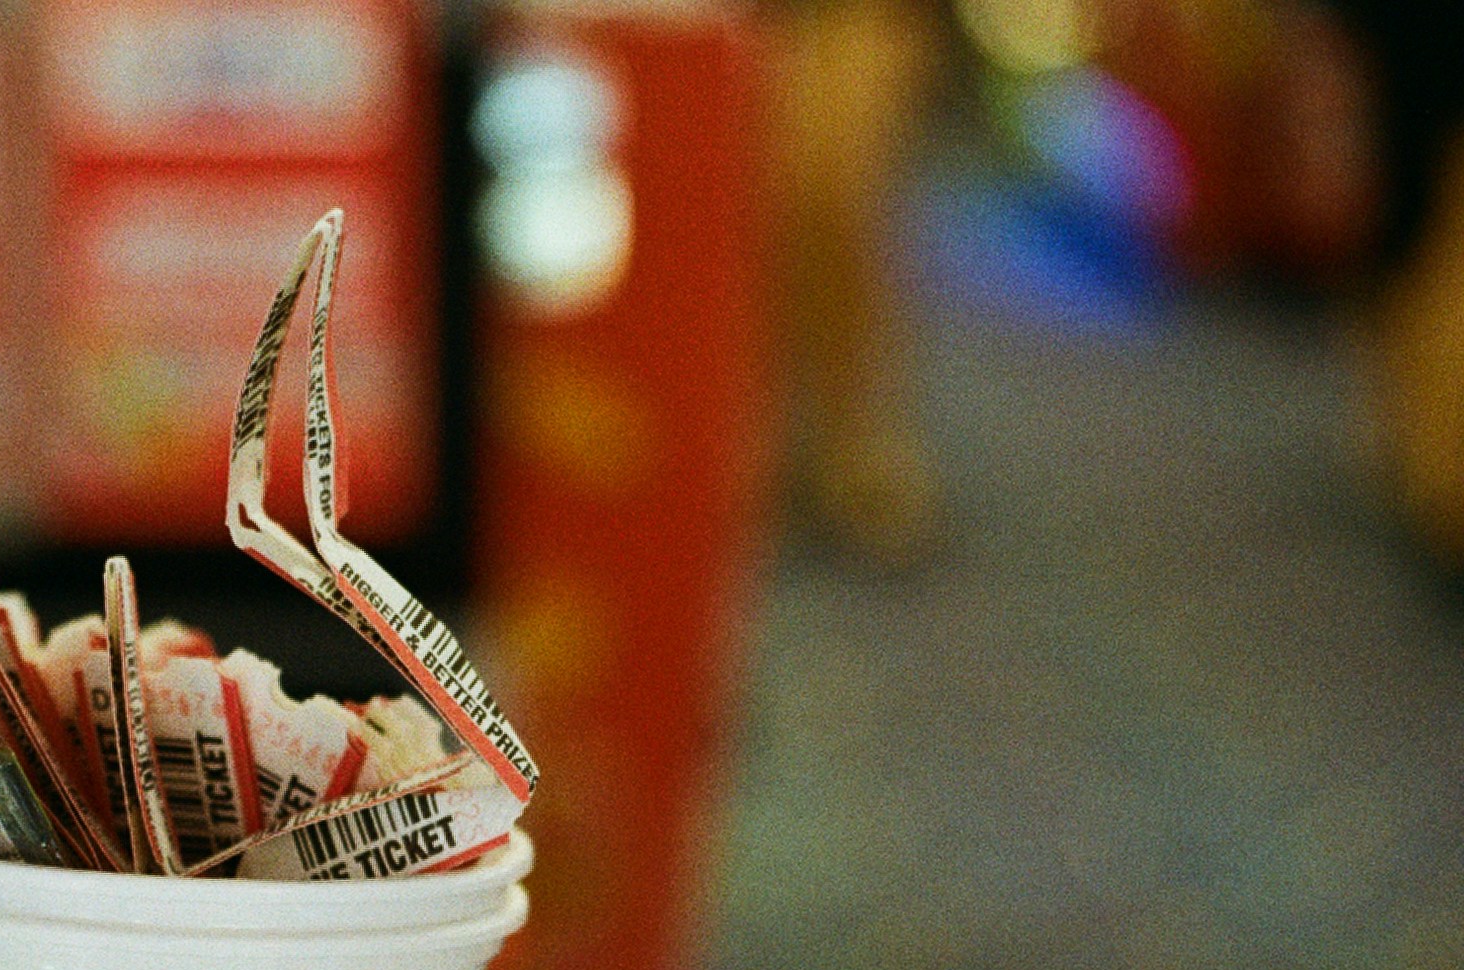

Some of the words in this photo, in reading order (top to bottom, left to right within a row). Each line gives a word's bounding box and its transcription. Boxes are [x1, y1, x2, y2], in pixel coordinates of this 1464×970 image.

[339, 562, 405, 633] BIGGER
[405, 633, 421, 652] &
[422, 650, 487, 727] BETTER
[195, 731, 239, 824] TICKET
[353, 814, 457, 880] TICKET
